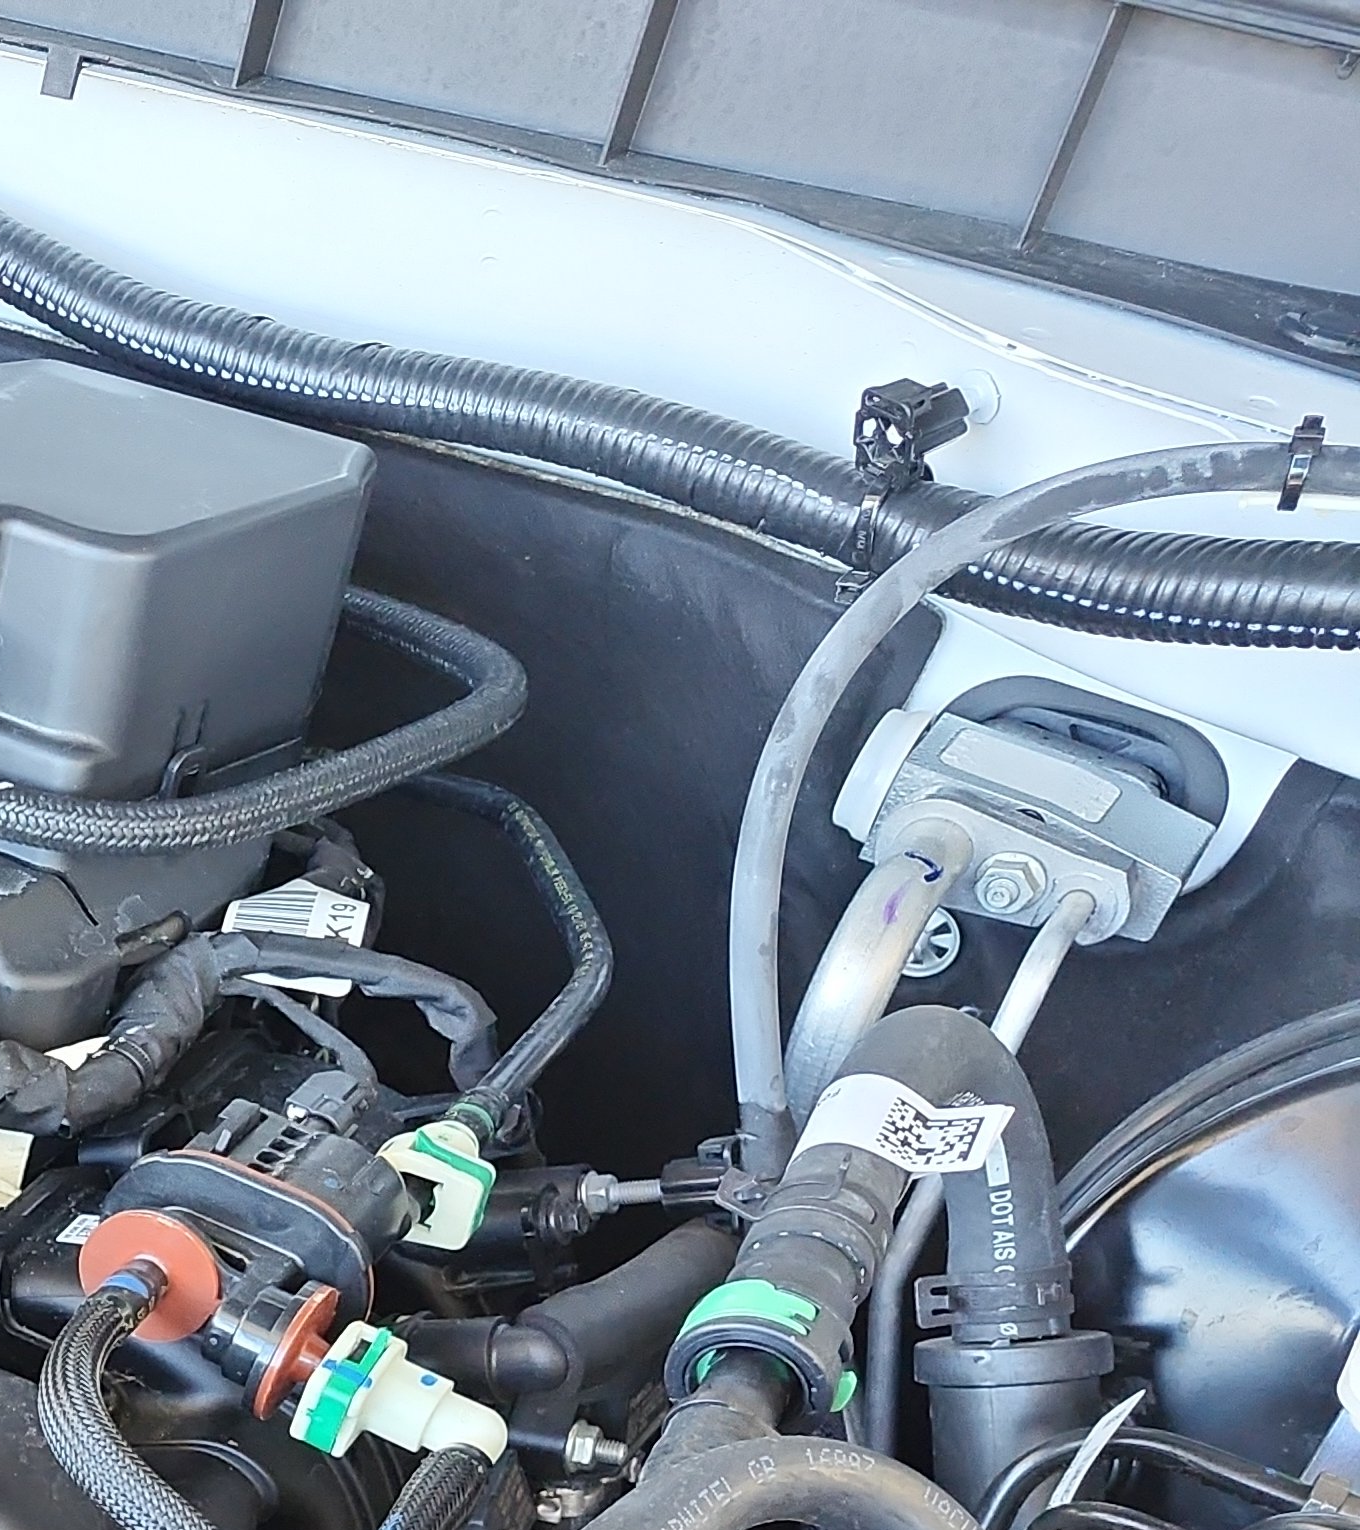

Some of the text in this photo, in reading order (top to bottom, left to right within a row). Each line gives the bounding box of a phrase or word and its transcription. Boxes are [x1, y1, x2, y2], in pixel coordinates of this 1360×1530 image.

[326, 902, 357, 939] K19
[988, 1189, 1017, 1261] DOT AIS
